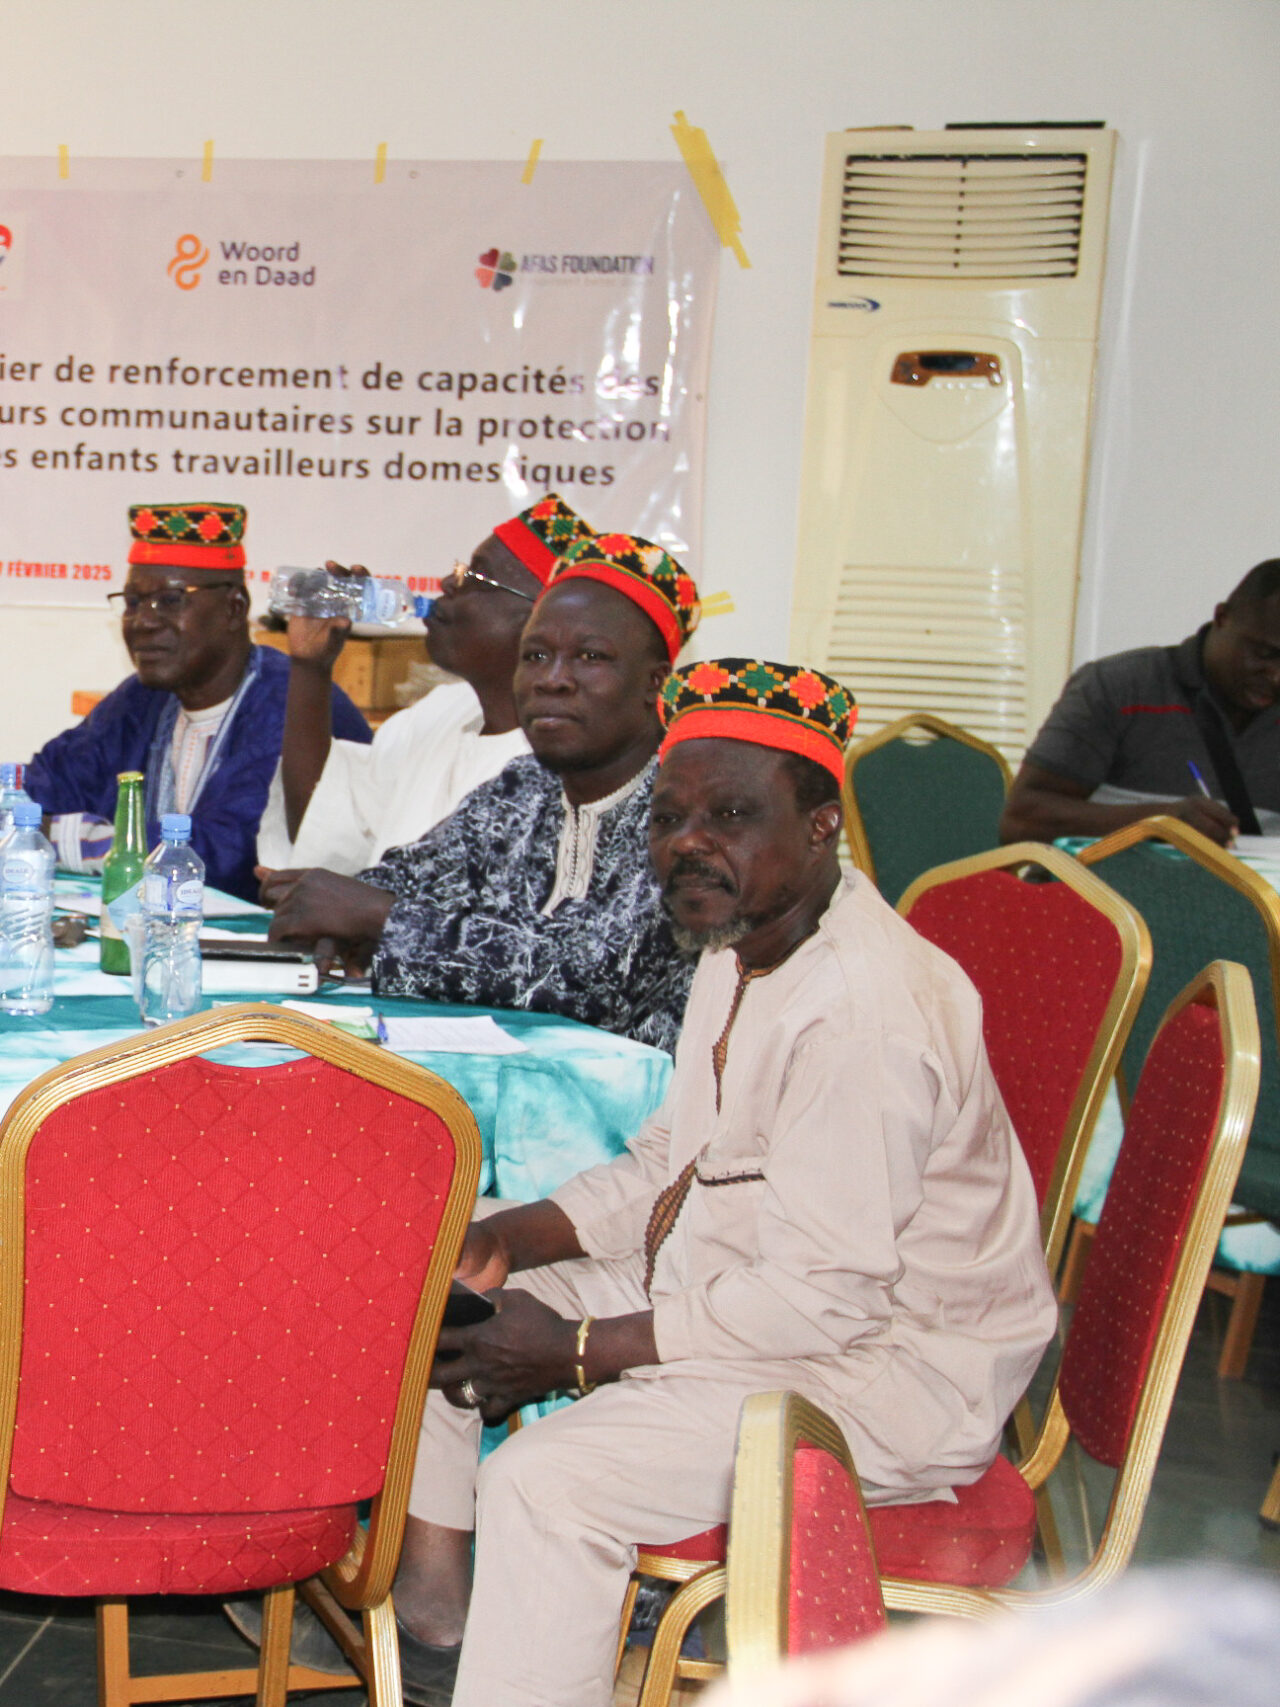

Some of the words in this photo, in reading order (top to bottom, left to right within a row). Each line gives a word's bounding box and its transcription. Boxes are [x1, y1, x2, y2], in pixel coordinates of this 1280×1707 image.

[220, 241, 300, 262] Woord
[218, 269, 247, 286] en
[255, 265, 316, 287] Daad
[54, 355, 96, 384] de
[108, 357, 349, 390] renforcement
[361, 362, 405, 391] de
[417, 365, 585, 400] capacités
[60, 404, 354, 435] communautaires
[366, 413, 422, 436] sur
[434, 408, 463, 437] la
[31, 441, 159, 472] enfants
[172, 446, 370, 480] travailleurs
[383, 452, 615, 492] domesiques
[7, 558, 68, 579] FÉVRIER
[72, 563, 112, 581] 2025
